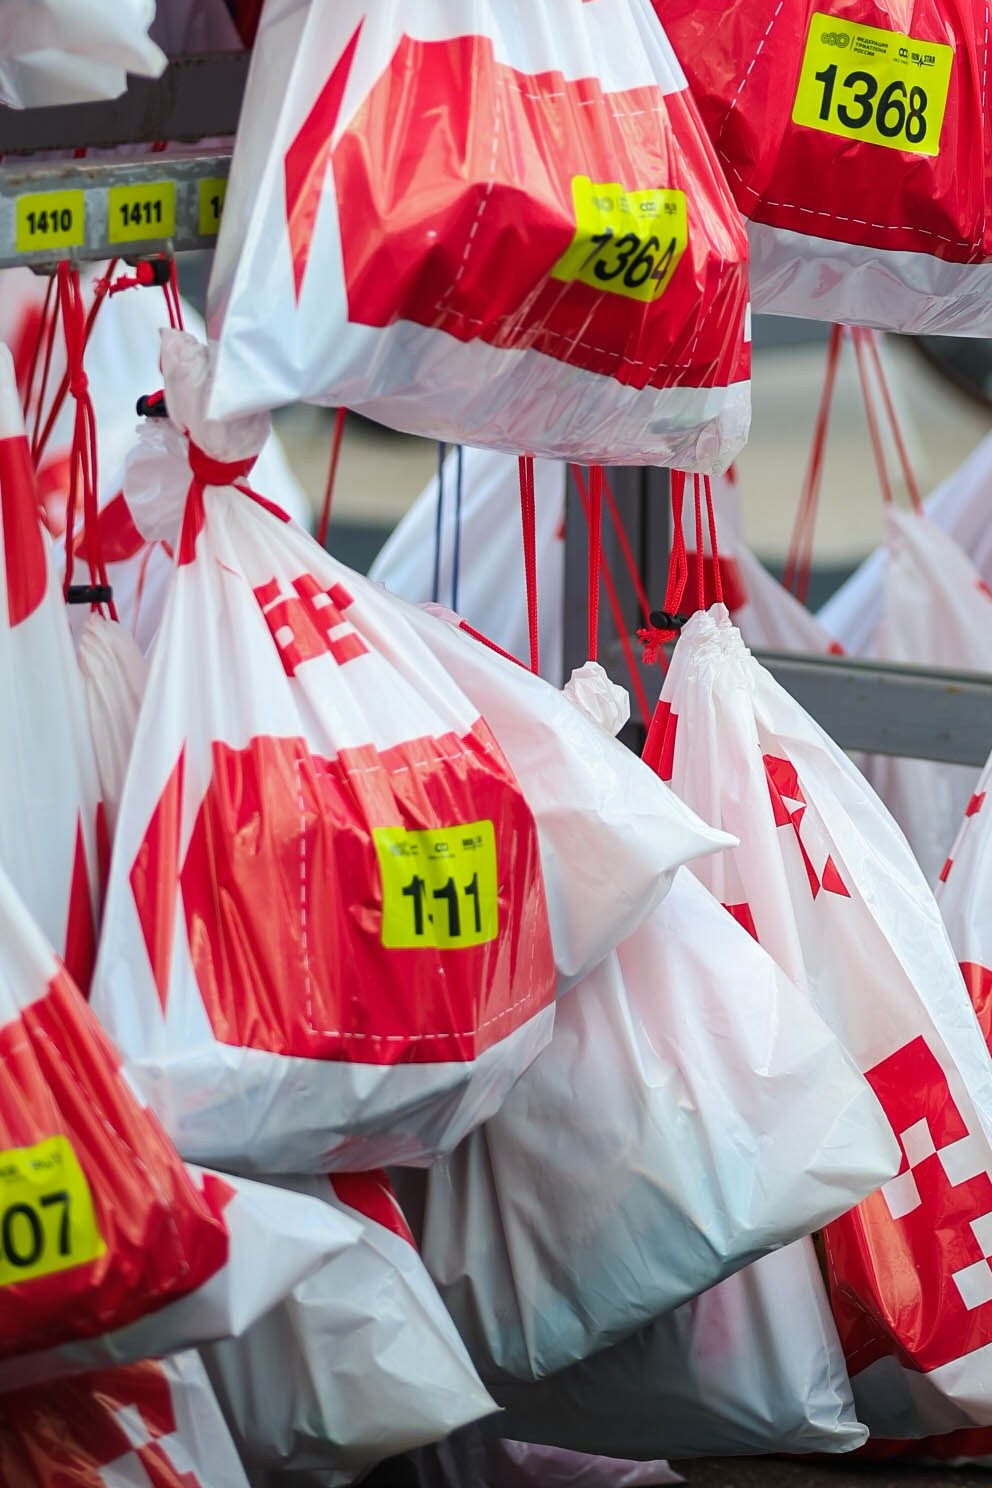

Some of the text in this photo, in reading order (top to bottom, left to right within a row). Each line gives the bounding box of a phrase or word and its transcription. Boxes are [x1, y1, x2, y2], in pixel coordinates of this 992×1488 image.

[815, 64, 928, 144] 1368
[27, 209, 72, 234] 1410
[120, 200, 162, 226] 1411
[580, 227, 676, 292] 1364
[402, 872, 481, 937] 111
